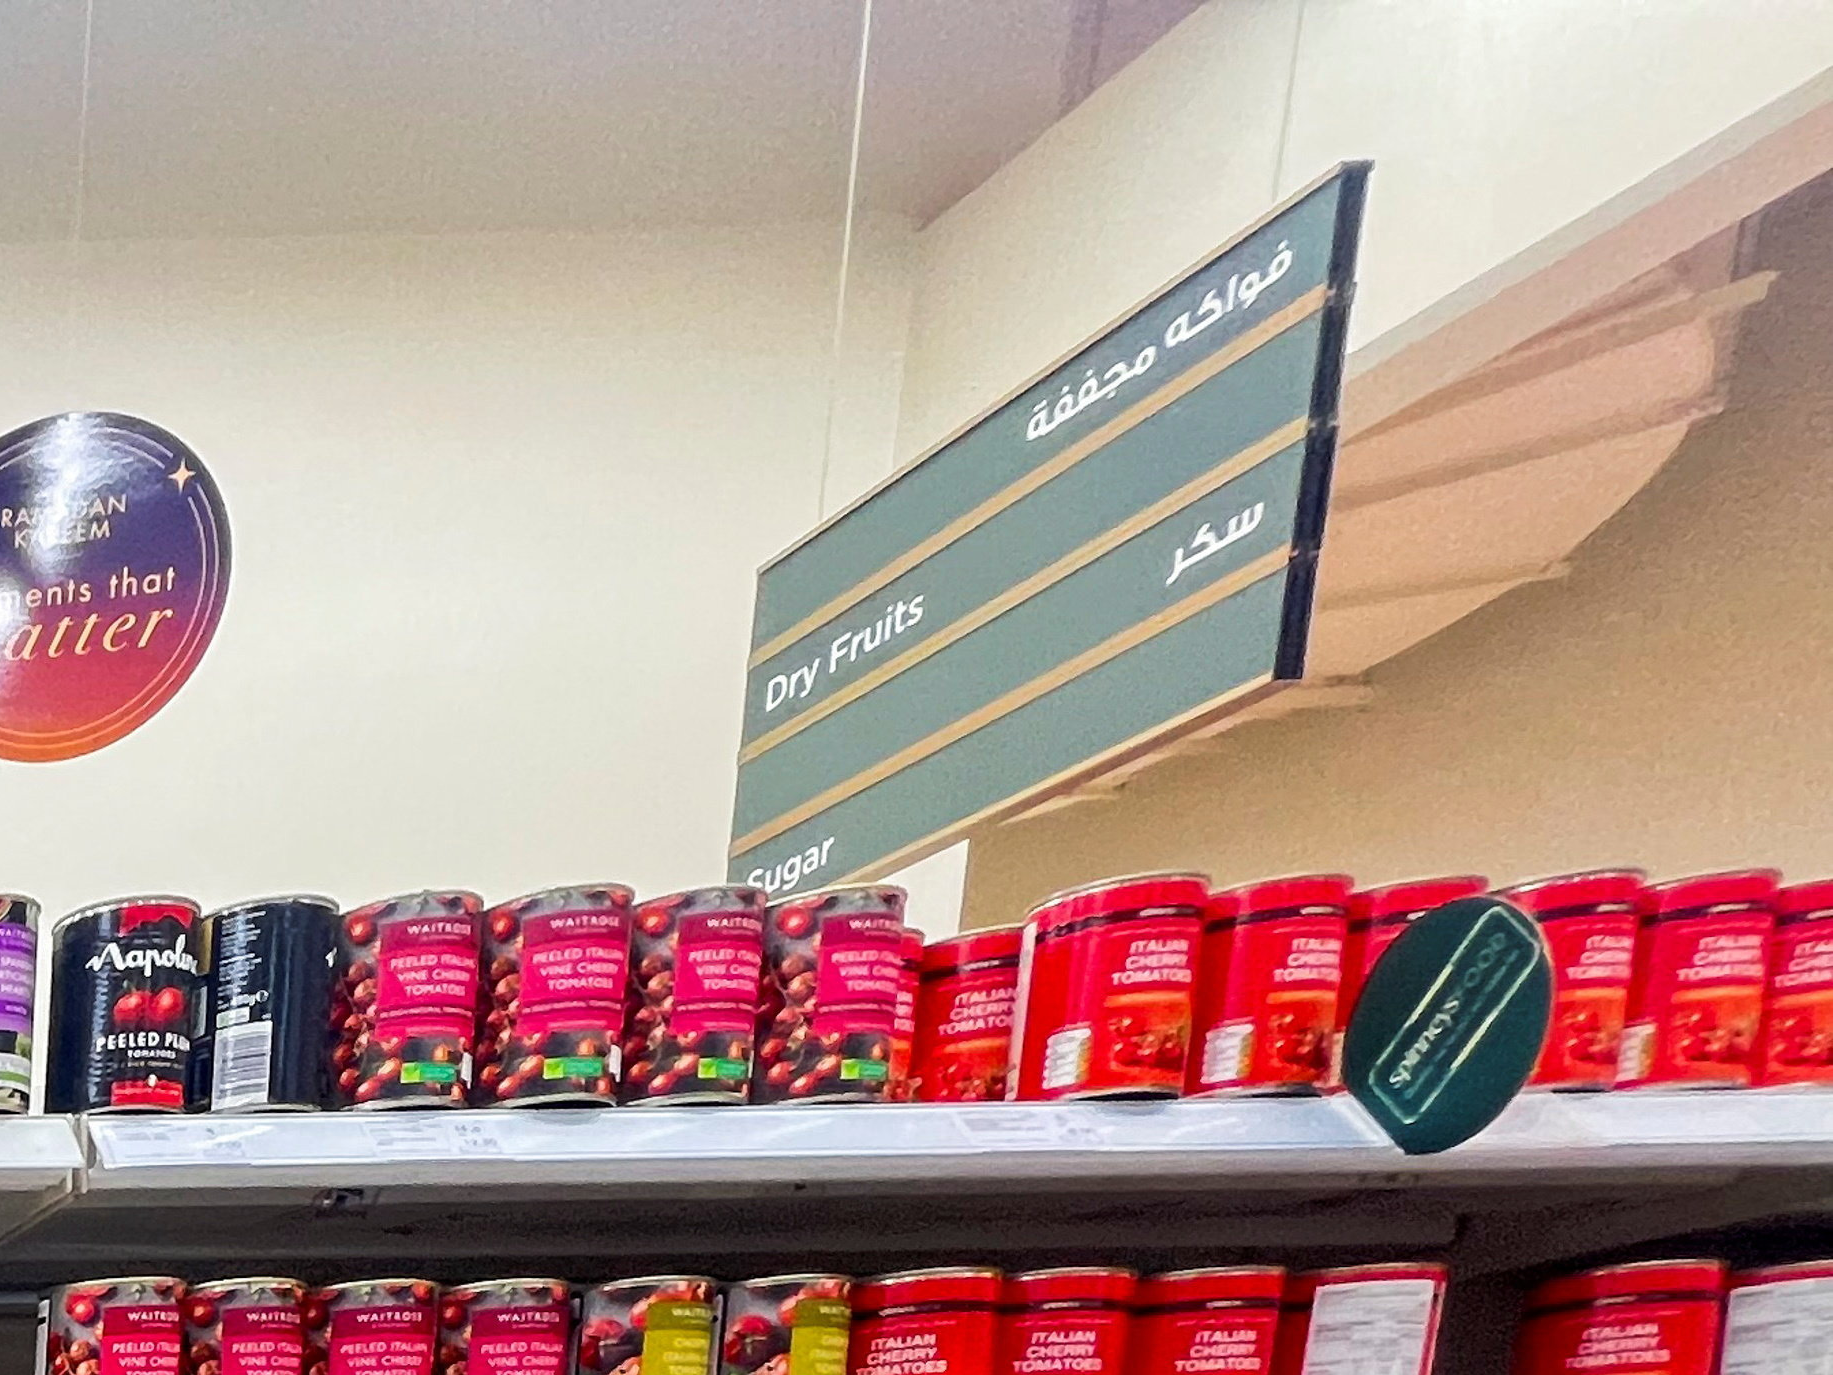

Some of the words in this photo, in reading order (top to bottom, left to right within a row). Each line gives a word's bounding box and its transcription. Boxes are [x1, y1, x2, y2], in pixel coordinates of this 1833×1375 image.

[1164, 240, 1293, 347] فواكه
[1025, 346, 1157, 441] مجففة
[1165, 501, 1265, 587] سكر
[109, 566, 176, 599] that
[4, 607, 174, 662] atter
[764, 673, 821, 713] Dry
[828, 595, 925, 675] Fruits
[746, 836, 836, 897] Sugar
[866, 1346, 939, 1365] CHERRY
[871, 1333, 938, 1351] ITALIAN
[1030, 1330, 1097, 1345] ITALIAN
